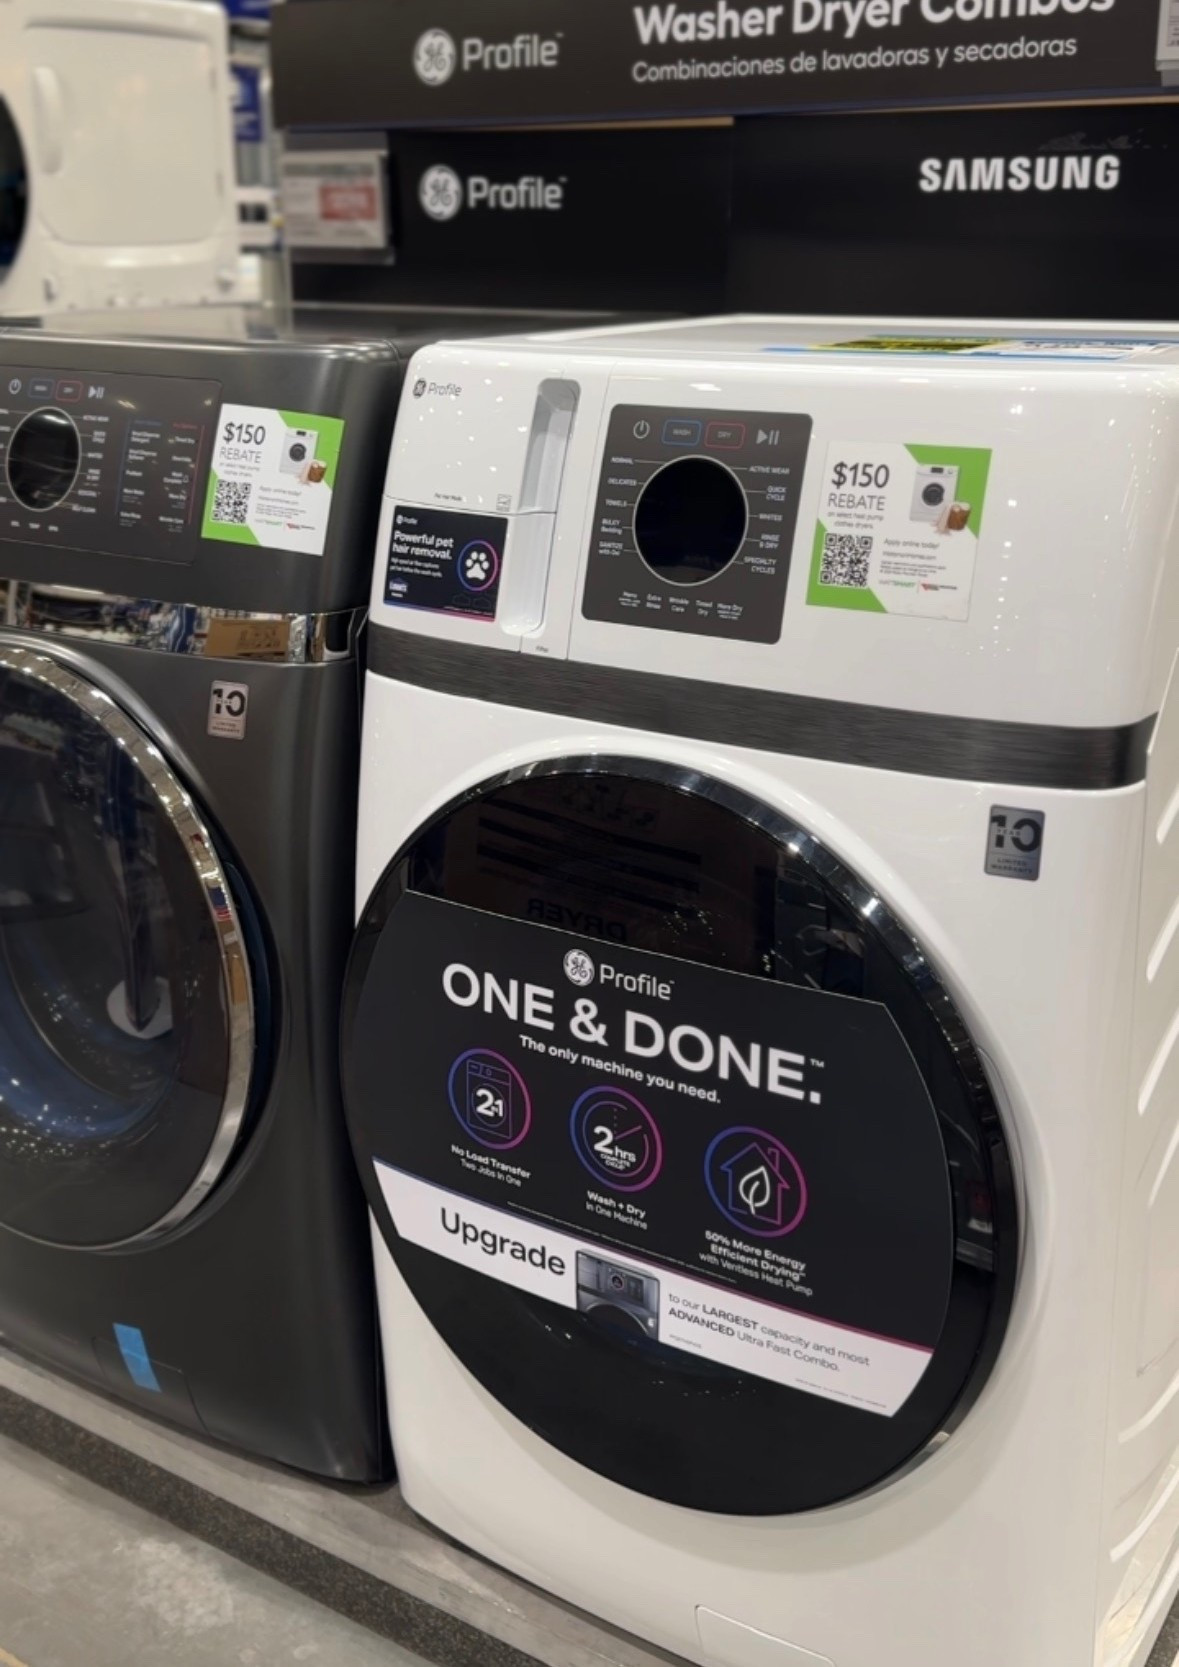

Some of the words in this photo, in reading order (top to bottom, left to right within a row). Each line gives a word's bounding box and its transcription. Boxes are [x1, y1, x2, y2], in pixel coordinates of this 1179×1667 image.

[633, 1, 784, 44] Washer
[792, 0, 909, 38] Dryer
[632, 56, 785, 83] Combinaciones
[790, 52, 817, 73] de
[822, 46, 930, 71] lavadoras
[936, 47, 949, 69] y
[954, 36, 1078, 62] secadoras
[919, 154, 1121, 192] SAMSUNG
[428, 381, 463, 397] Profile
[222, 421, 267, 446] $150
[717, 430, 733, 439] DRY
[219, 446, 262, 464] REBATE
[611, 456, 634, 465] NORMAL
[749, 465, 770, 473] ACTIVE
[771, 467, 791, 475] WEAR
[831, 461, 890, 490] $150
[605, 498, 628, 508] TOWELS
[766, 493, 786, 503] CYCLE
[767, 485, 788, 493] QUICK
[827, 492, 887, 511] REBATE
[392, 541, 410, 554] hair
[410, 546, 453, 560] removal.
[393, 530, 435, 545] Powerful
[436, 536, 454, 548] pet
[761, 534, 780, 542] RINSE
[751, 565, 776, 575] CYCLES
[213, 688, 246, 717] 10
[991, 814, 1043, 853] 10
[442, 962, 555, 1031] ONE
[569, 997, 609, 1047] &
[518, 1033, 545, 1053] The
[548, 1046, 579, 1065] only
[581, 1054, 644, 1082] machine
[646, 1072, 675, 1090] you
[677, 1081, 721, 1105] need.
[593, 1125, 614, 1155] 2
[614, 1144, 637, 1164] hrs
[450, 1143, 465, 1157] No
[465, 1149, 489, 1166] Load
[490, 1157, 532, 1180] Transfer
[460, 1157, 477, 1172] Two
[478, 1164, 497, 1178] Jobs
[505, 1173, 522, 1187] One
[585, 1200, 594, 1212] In
[595, 1204, 613, 1218] One
[613, 1211, 648, 1231] Machine
[586, 1189, 617, 1209] Wash
[618, 1201, 625, 1211] +
[626, 1203, 647, 1219] Dry
[440, 1206, 567, 1277] Upgrade
[705, 1229, 731, 1247] 50%
[732, 1238, 762, 1257] More
[764, 1248, 806, 1271] Energy
[710, 1242, 759, 1268] Efficient
[698, 1252, 720, 1266] with
[720, 1258, 760, 1280] Ventless
[760, 1271, 784, 1288] Heat
[785, 1279, 814, 1298] Pump
[667, 1306, 736, 1338] ADVANCED
[736, 1330, 765, 1349] Ultra
[765, 1340, 792, 1358] Fast
[793, 1349, 841, 1372] Combo.
[668, 1293, 681, 1305] to
[681, 1298, 701, 1311] our
[702, 1303, 760, 1331] LARGEST
[759, 1325, 812, 1350] capacity
[812, 1342, 836, 1357] and
[837, 1348, 871, 1367] most
